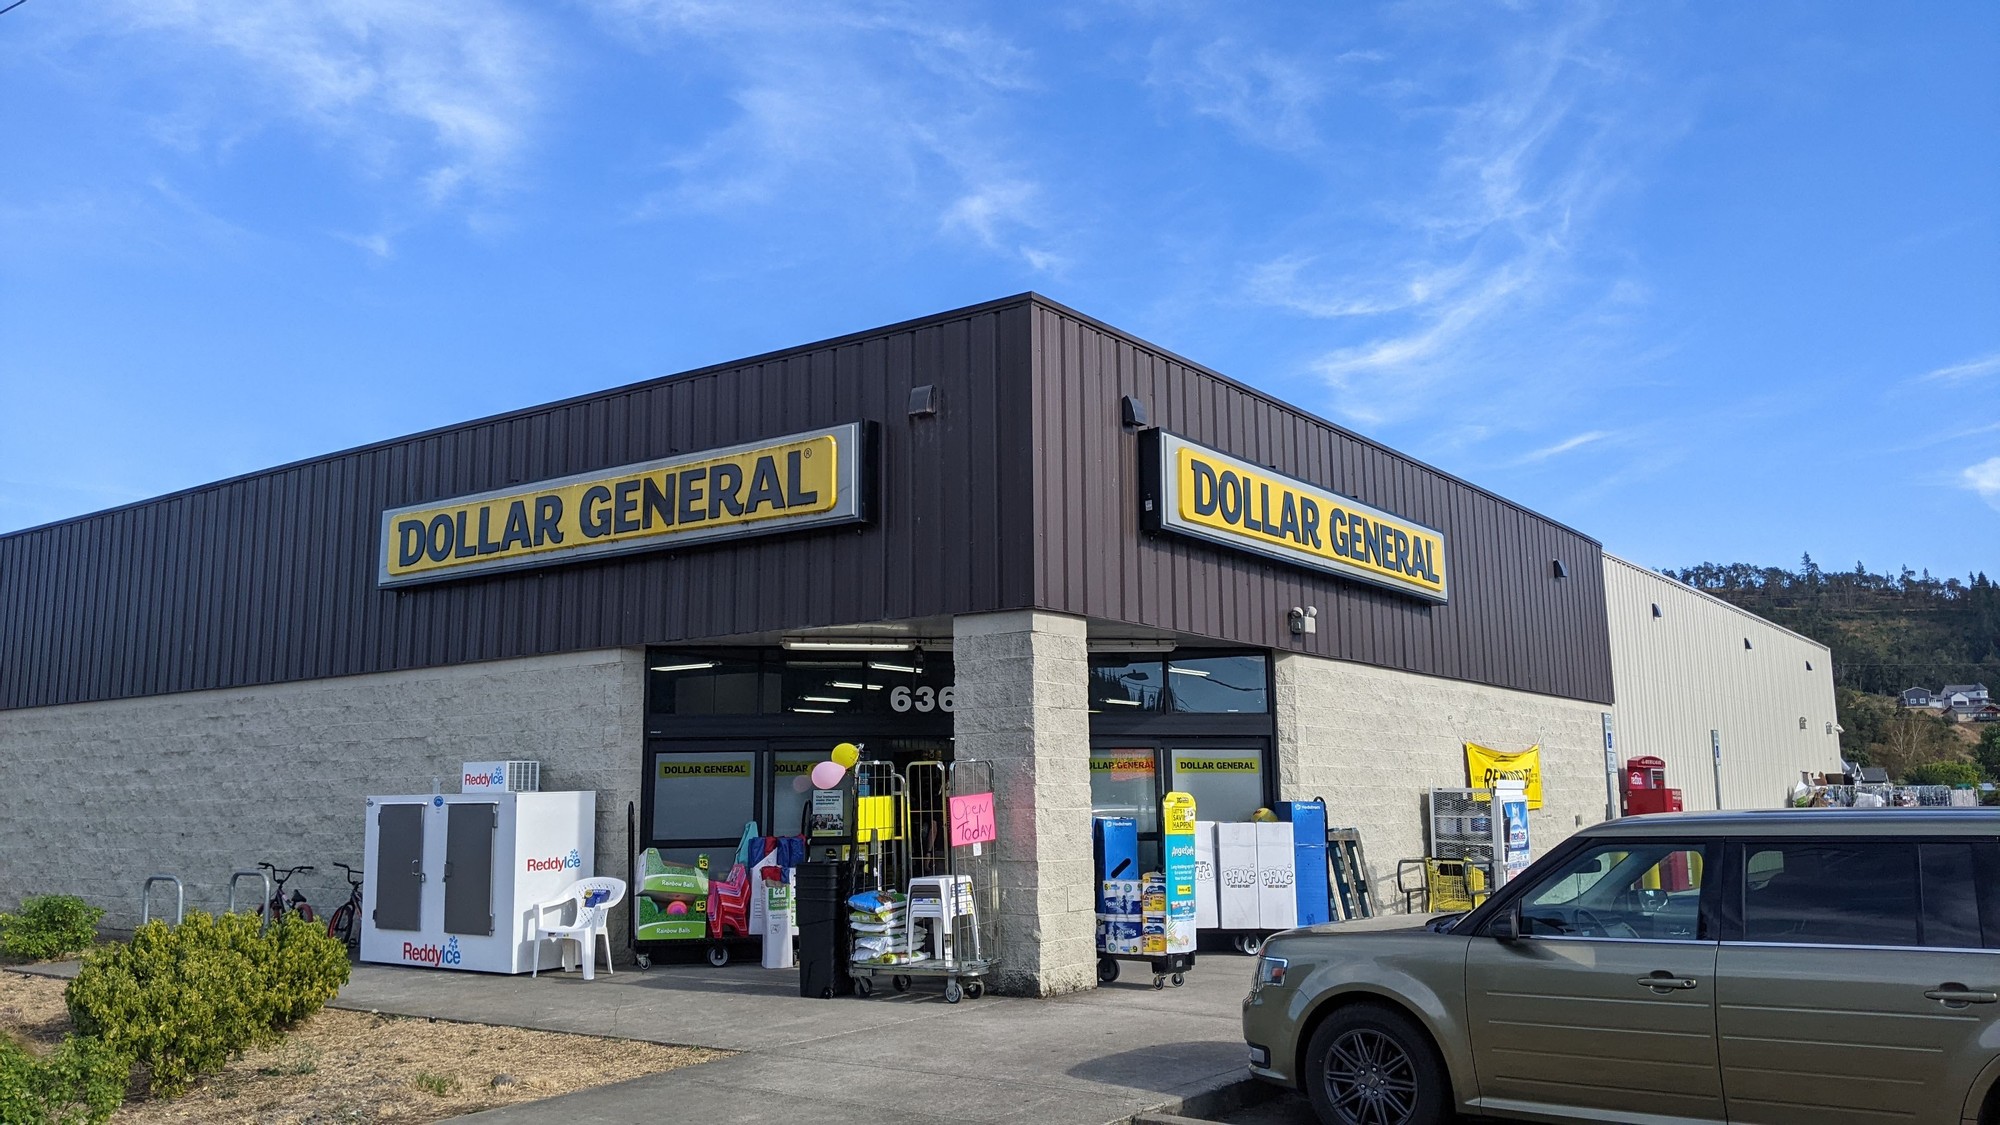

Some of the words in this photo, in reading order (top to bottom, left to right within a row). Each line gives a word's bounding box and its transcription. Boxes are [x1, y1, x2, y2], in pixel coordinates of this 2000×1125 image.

[398, 494, 564, 567] DOLLAR
[1191, 459, 1322, 549] DOLLAR
[1330, 507, 1440, 584] GENERAL
[664, 765, 702, 774] DOLLAR
[703, 764, 746, 773] GENERAL
[1180, 761, 1214, 770] DOLLAR
[1216, 761, 1255, 770] GENERAL
[527, 856, 581, 872] ReddyIce
[403, 941, 461, 967] ReddyIce
